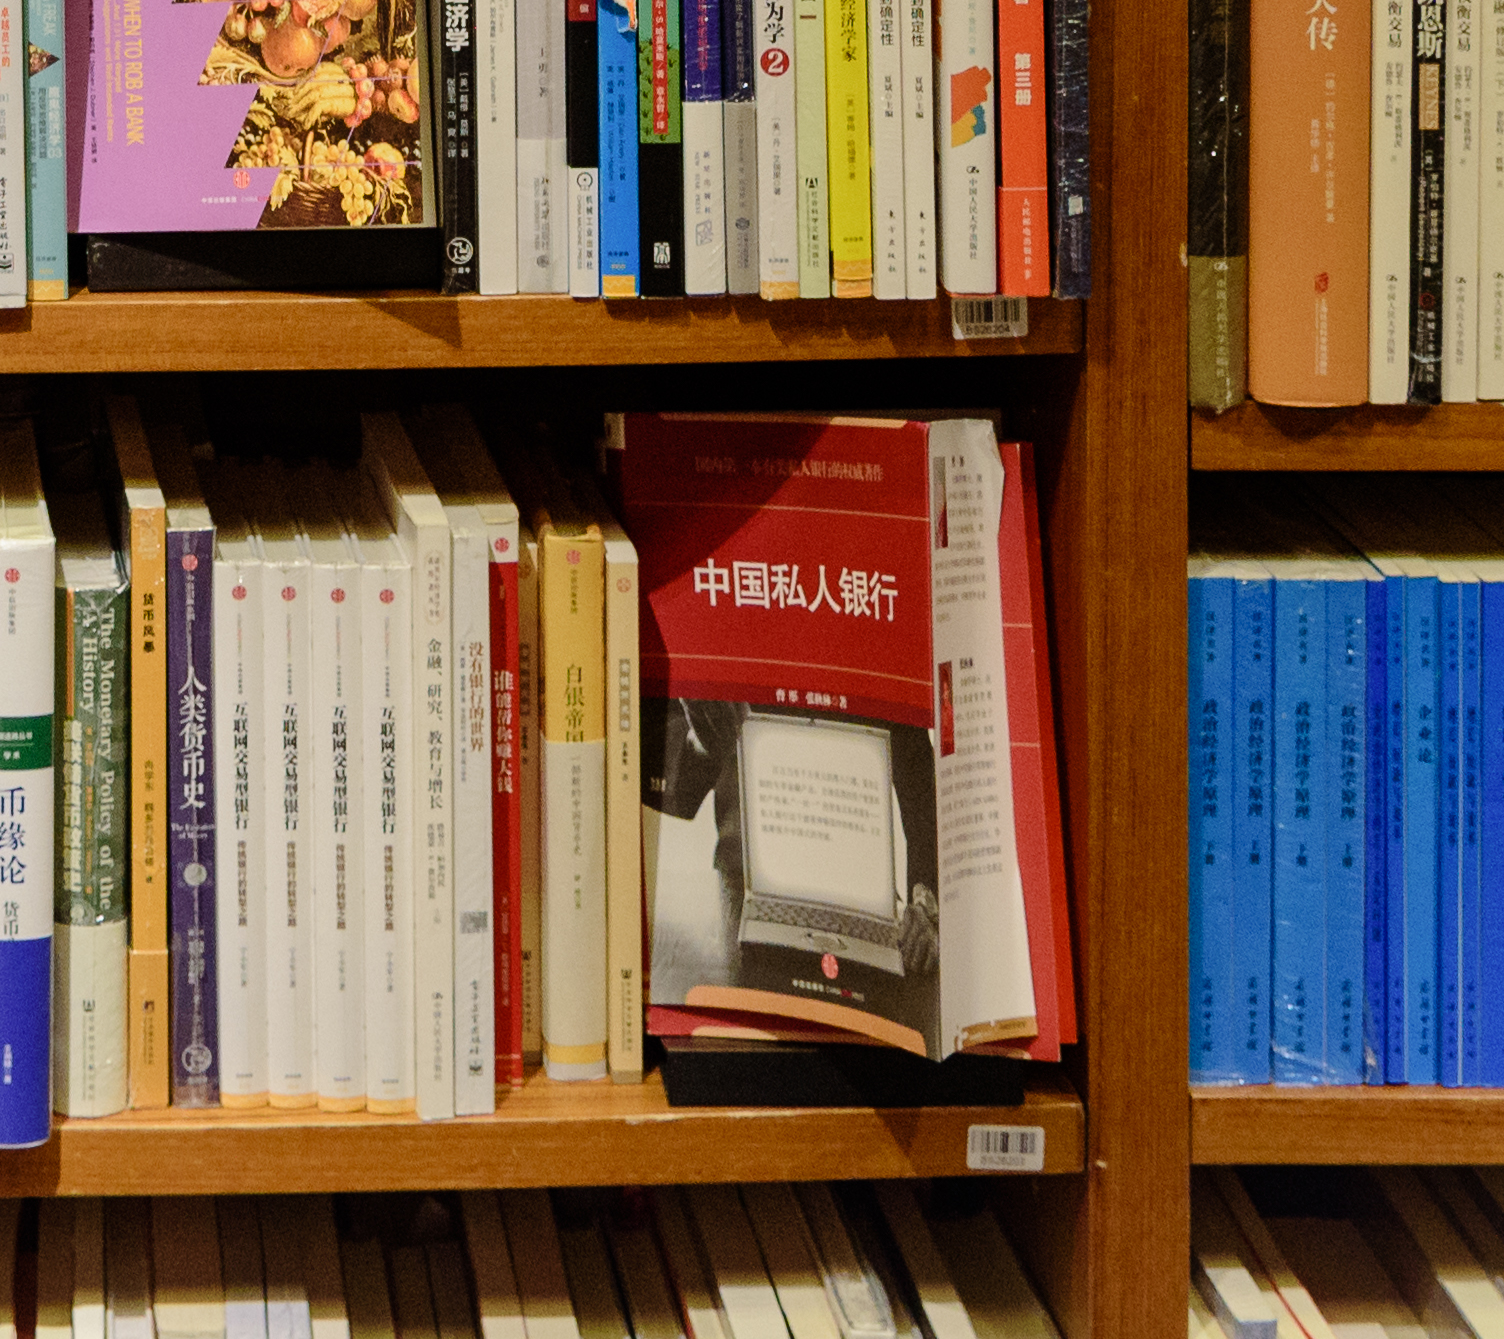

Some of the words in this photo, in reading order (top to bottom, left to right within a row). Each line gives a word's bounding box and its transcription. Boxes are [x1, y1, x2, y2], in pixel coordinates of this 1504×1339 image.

[1014, 53, 1031, 106] 第三册
[694, 557, 897, 623] 中国私人银行
[178, 666, 205, 811] 人类货币史
